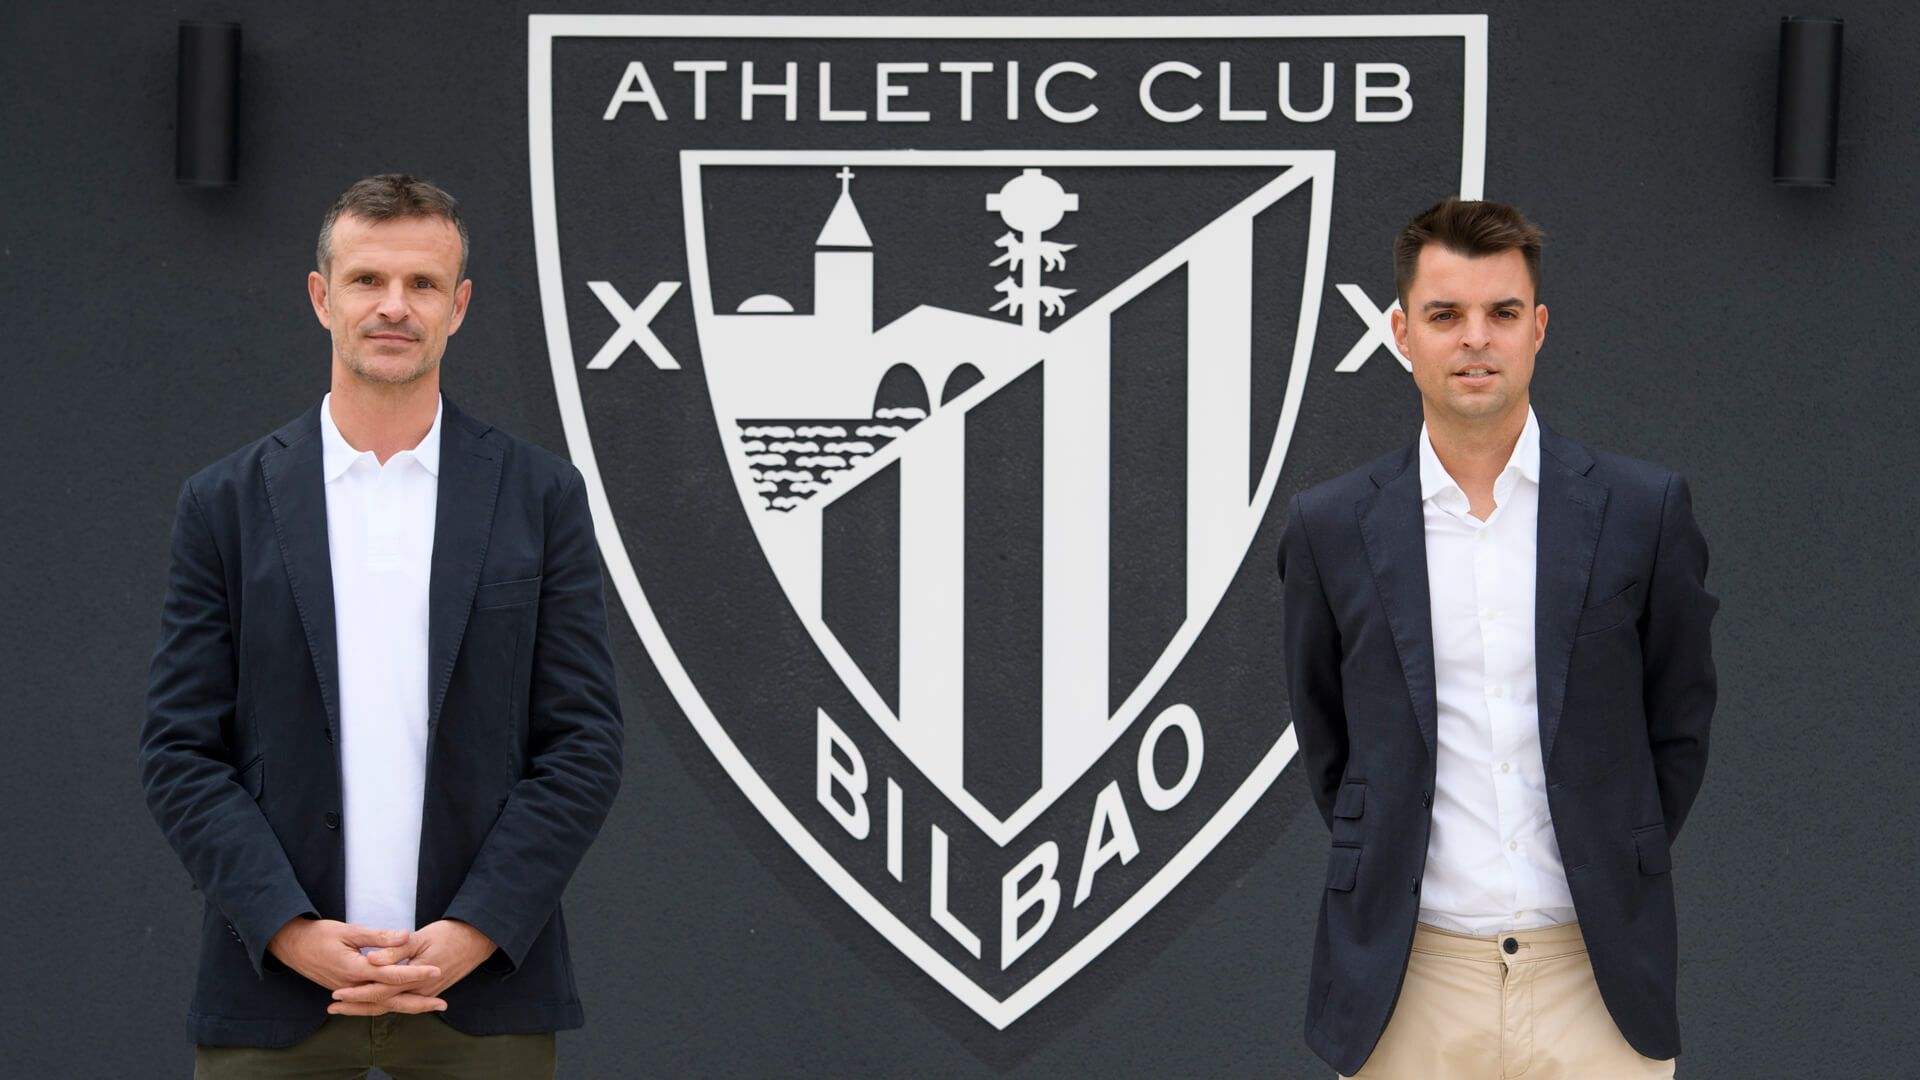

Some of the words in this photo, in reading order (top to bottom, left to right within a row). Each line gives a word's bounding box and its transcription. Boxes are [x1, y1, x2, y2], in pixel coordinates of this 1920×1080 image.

[603, 61, 1099, 123] ATHLETIC
[1139, 61, 1413, 123] CLUB
[816, 703, 1205, 971] BILBAO
